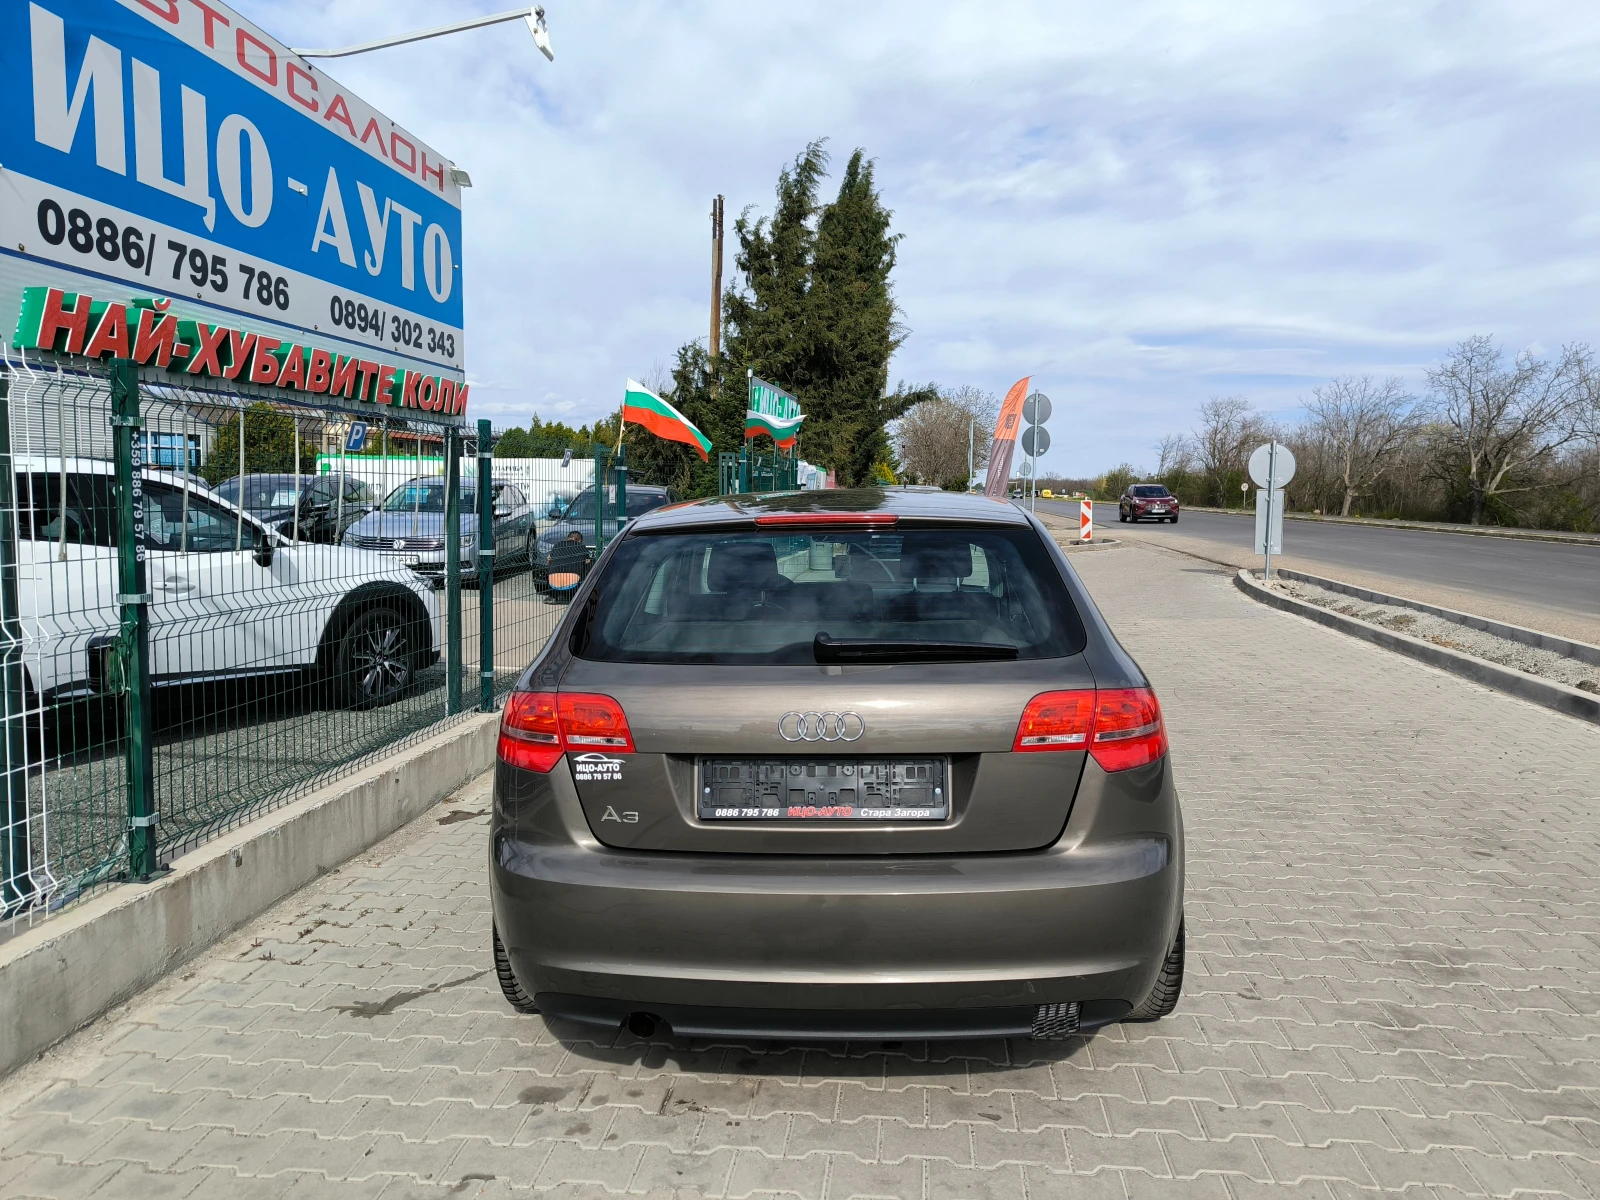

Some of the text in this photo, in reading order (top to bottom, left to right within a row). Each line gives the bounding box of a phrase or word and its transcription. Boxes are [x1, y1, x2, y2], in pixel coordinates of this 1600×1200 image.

[37, 199, 290, 311] 0886/ 795 786
[330, 295, 455, 358] 0894/ 302 343
[36, 286, 470, 416] НАЙ-ХУБАВИТЕ КОЛИ
[131, 431, 146, 562] +359 886 79 57 86
[575, 763, 620, 773] ИЦО-АУТО
[600, 805, 639, 824] A3
[715, 808, 780, 817] 0886 795 786
[787, 806, 852, 818] ИЦО-АУТО
[860, 808, 930, 818] Стара Загора
